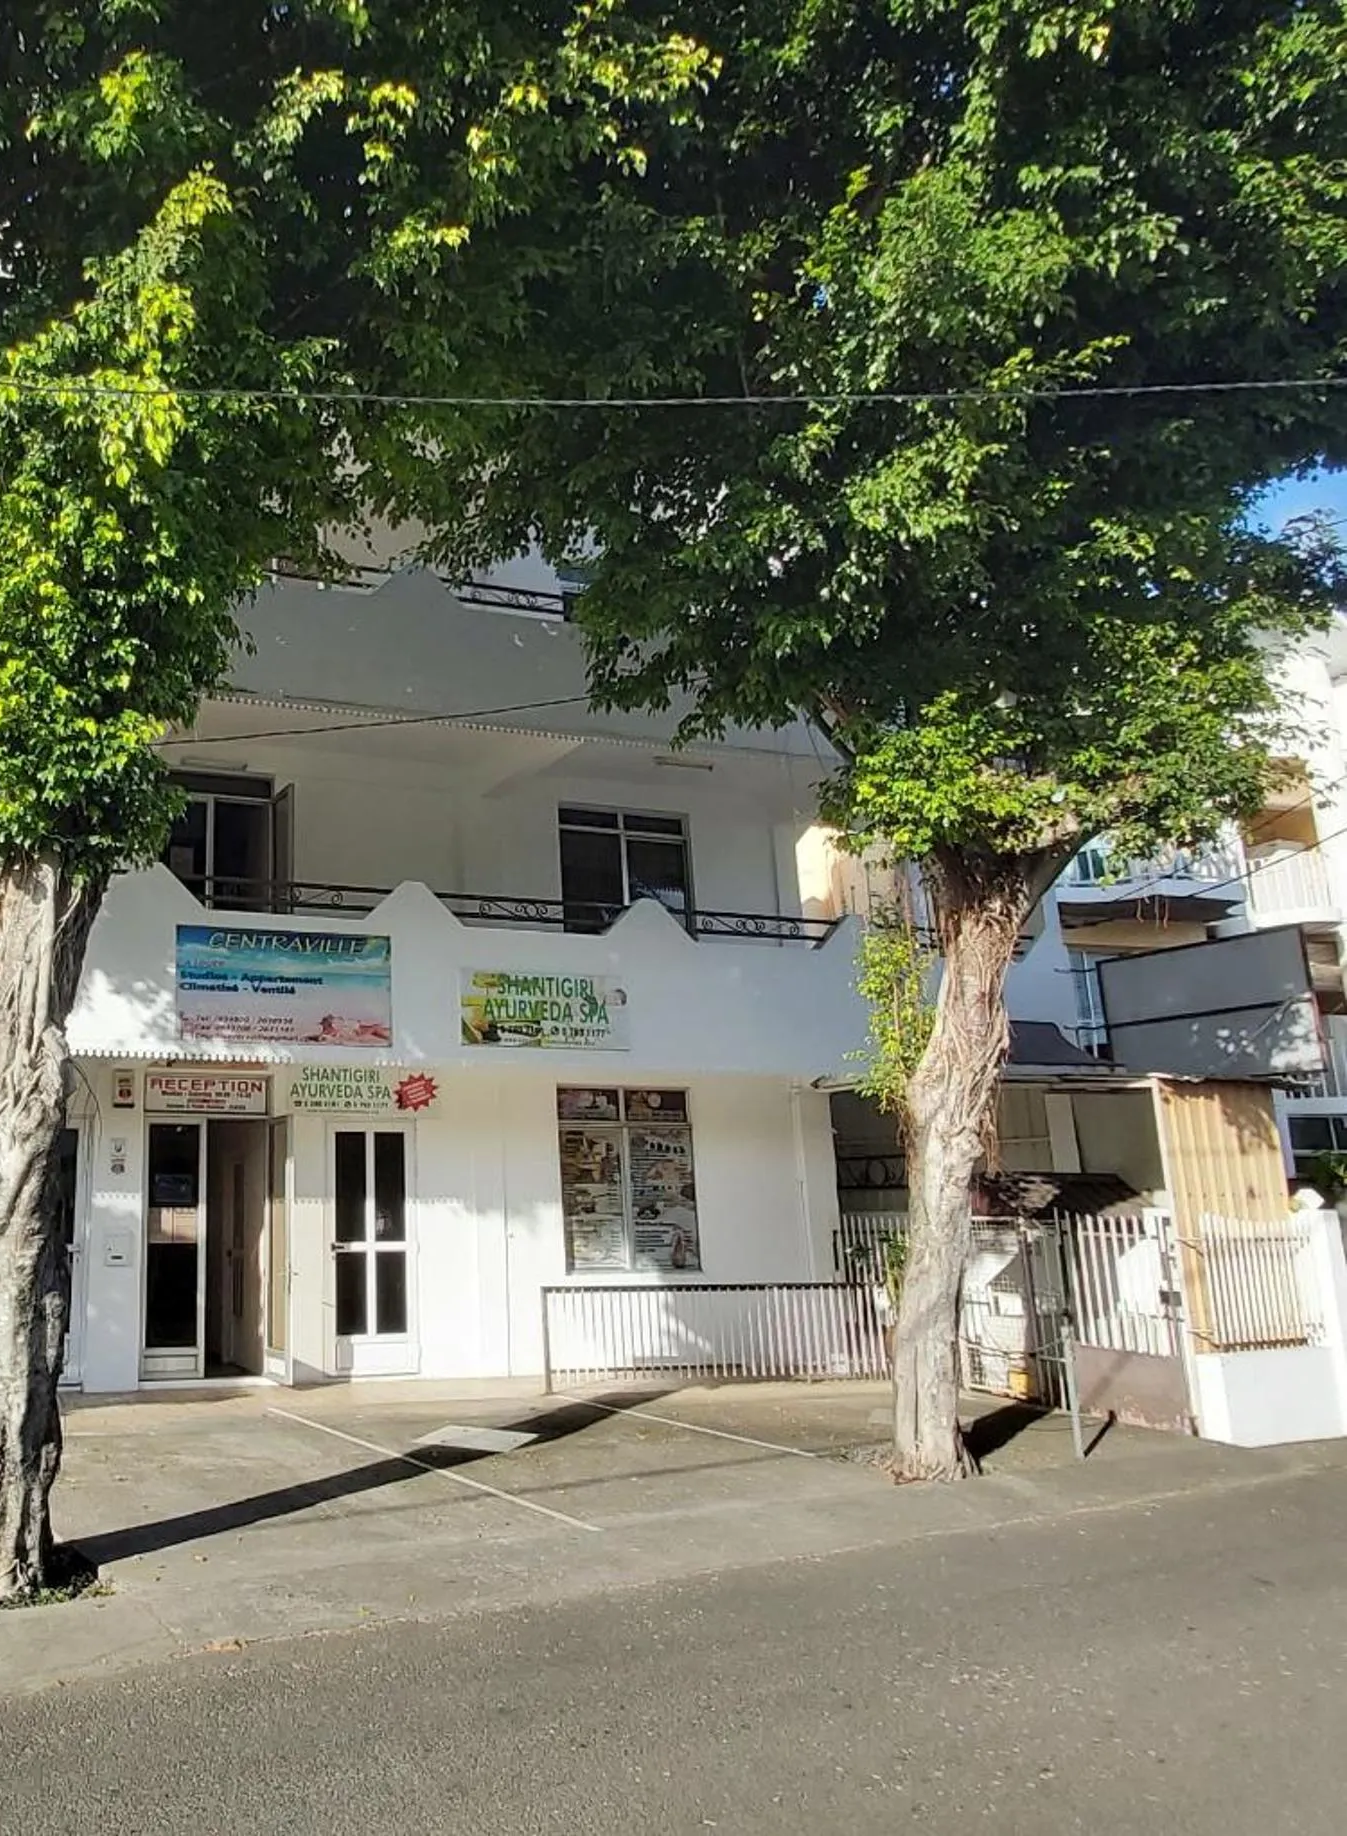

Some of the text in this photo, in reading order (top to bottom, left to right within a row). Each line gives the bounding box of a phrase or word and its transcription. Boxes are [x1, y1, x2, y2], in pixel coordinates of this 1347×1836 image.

[208, 931, 366, 954] CENTRAVILLE
[241, 972, 324, 986] Appartement
[497, 974, 594, 998] SHANTIGIRI
[484, 998, 610, 1025] AYURVEDA SPA
[302, 1067, 380, 1083] SHANTIGIRI
[150, 1077, 263, 1093] RECEPTION
[290, 1083, 363, 1099] AYURVEDA
[367, 1085, 392, 1099] SPA
